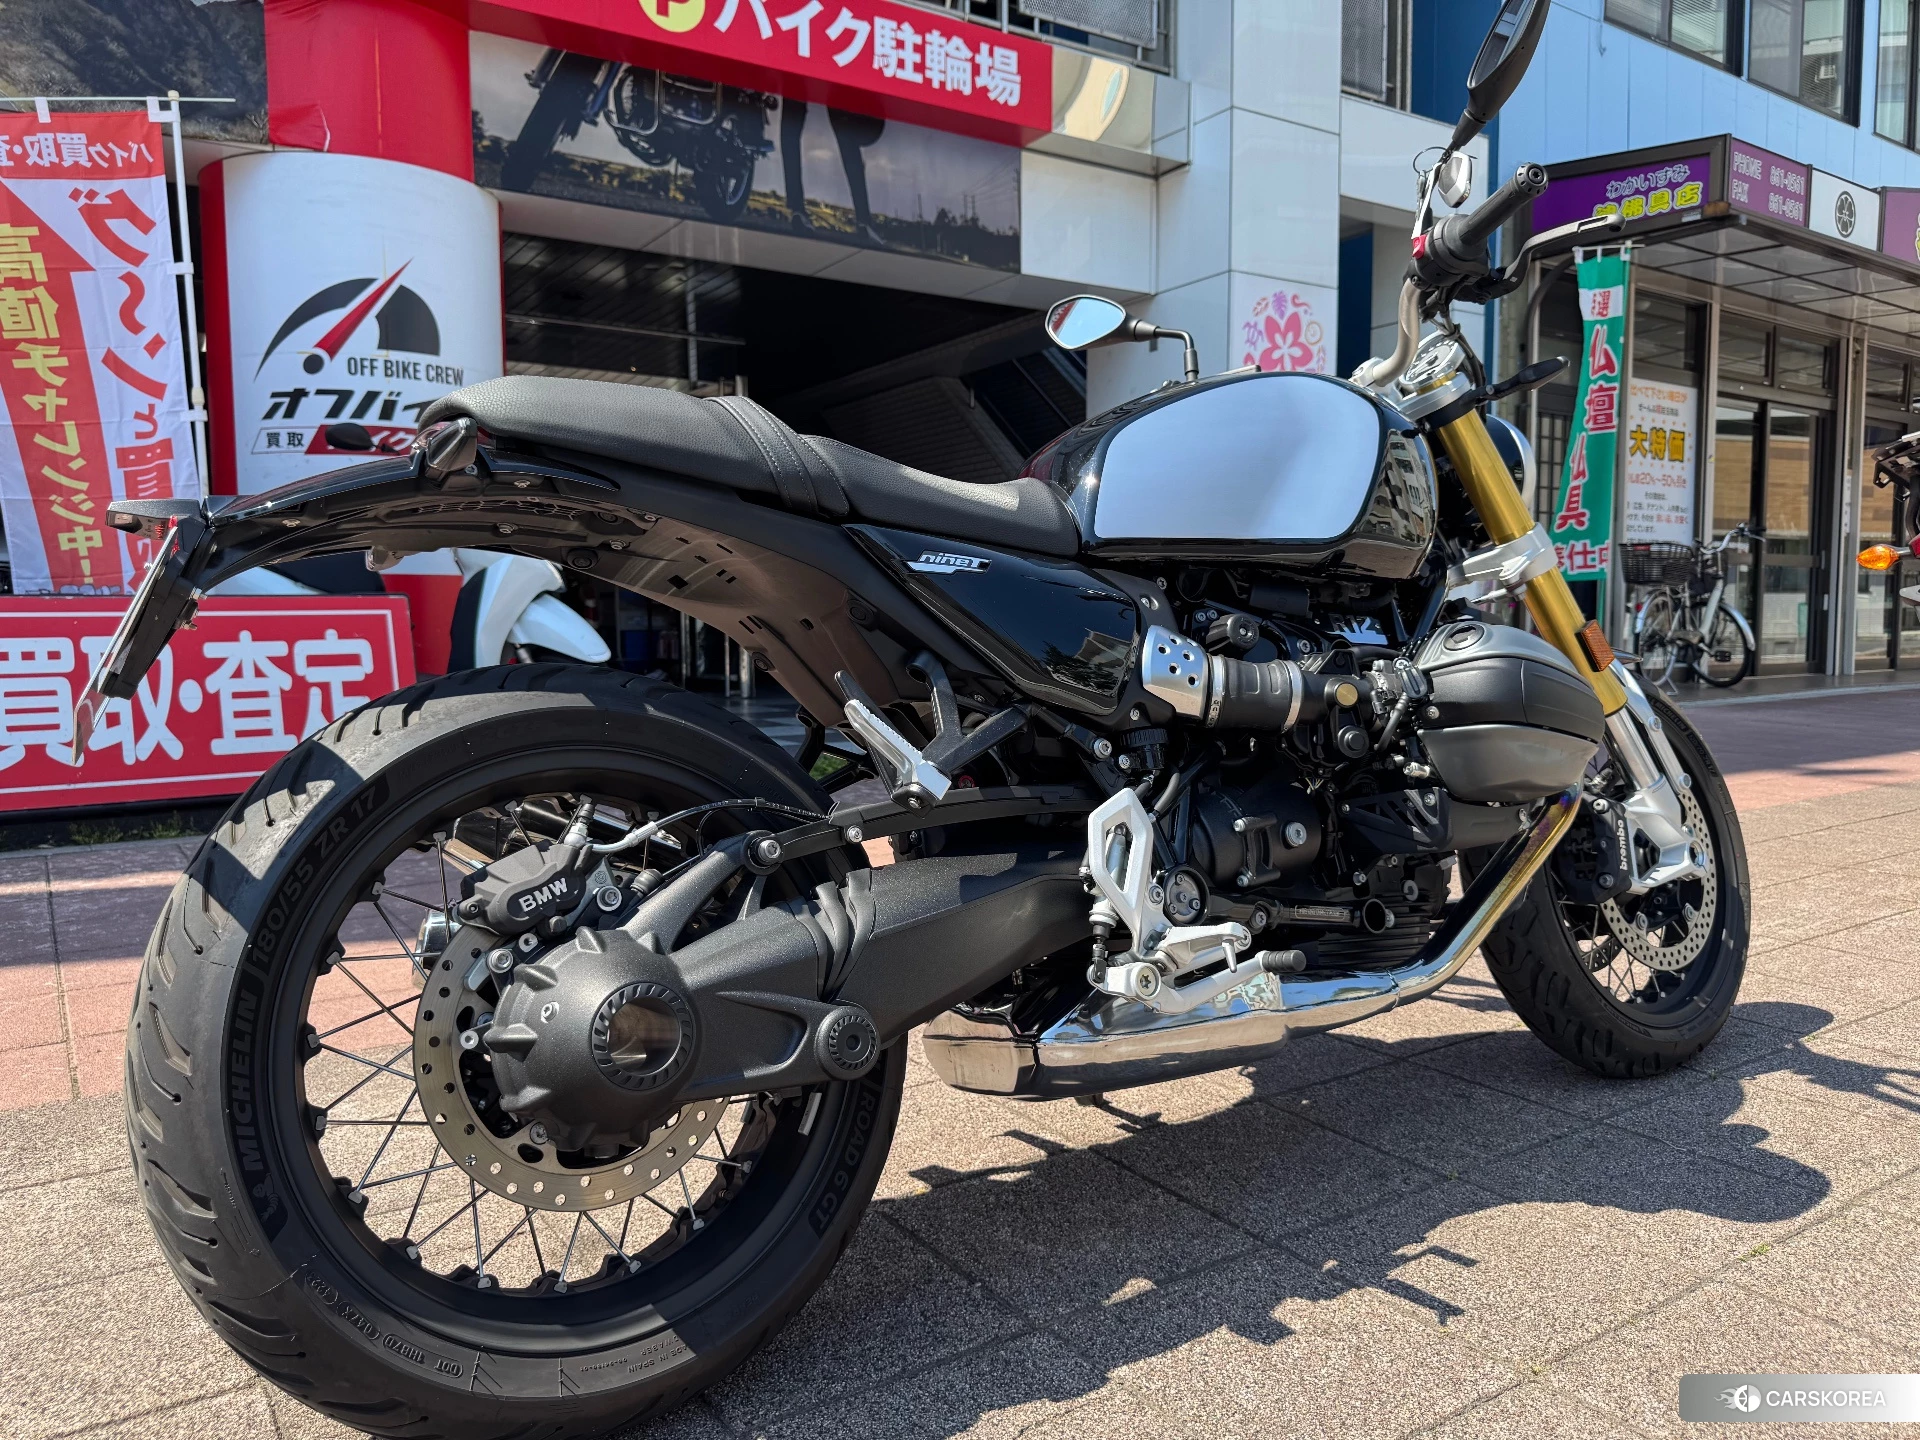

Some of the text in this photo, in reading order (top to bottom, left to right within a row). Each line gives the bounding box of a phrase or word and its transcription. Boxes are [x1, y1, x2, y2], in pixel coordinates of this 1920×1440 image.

[1731, 179, 1749, 203] FAX
[347, 356, 465, 387] OFF BIKE CREW
[266, 431, 304, 449] 買取
[1629, 424, 1685, 462] 大特価
[1617, 819, 1628, 870] brembo
[253, 785, 376, 967] 180/55 ZR 17
[518, 876, 569, 913] BMW
[231, 989, 264, 1172] MICHELIN
[815, 1091, 875, 1230] ROAD 6 GT
